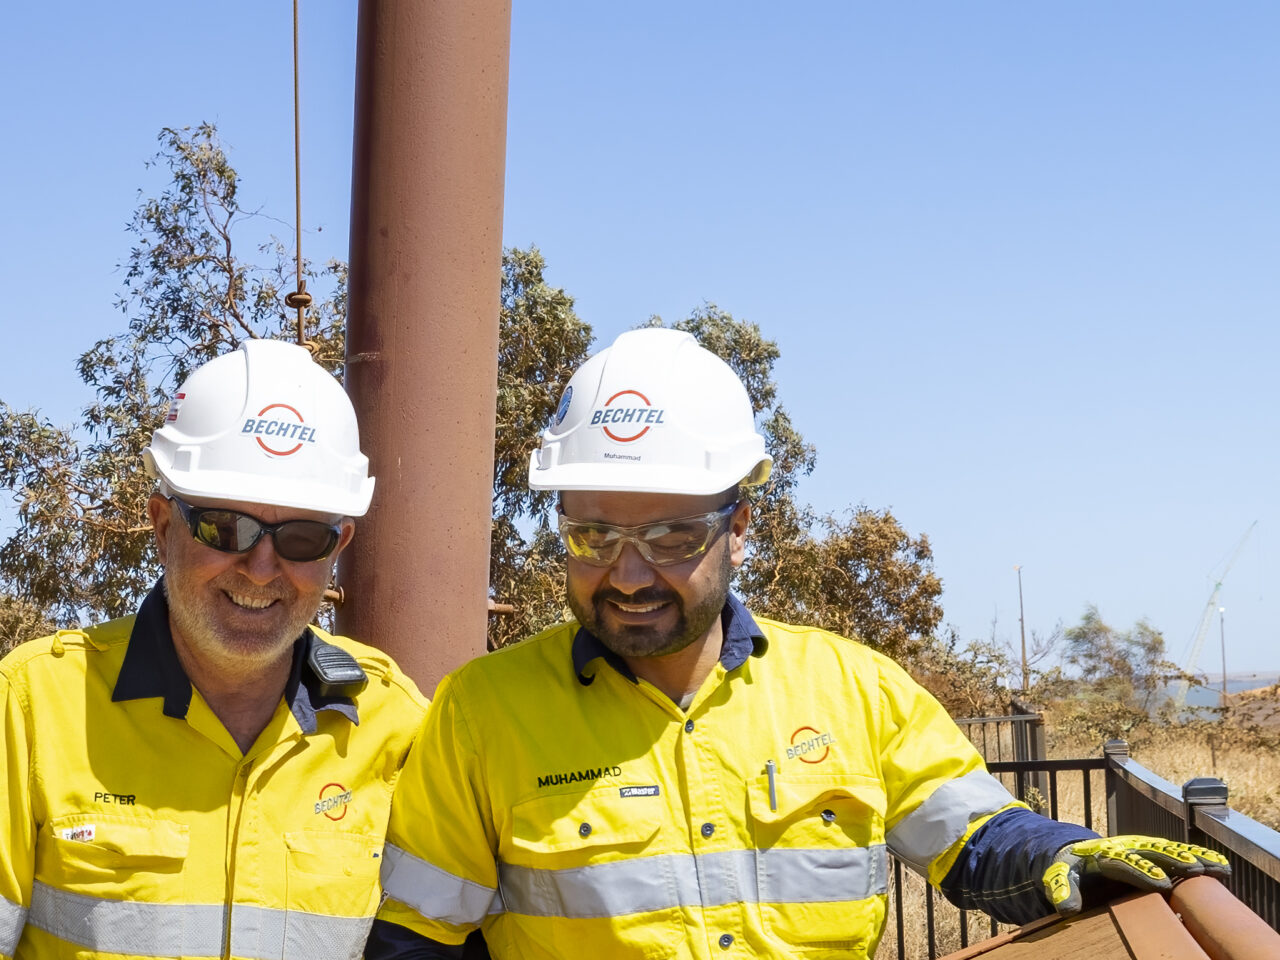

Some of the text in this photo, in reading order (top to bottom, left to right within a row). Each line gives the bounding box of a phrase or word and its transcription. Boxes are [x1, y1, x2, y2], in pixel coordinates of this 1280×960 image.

[590, 408, 665, 425] BECHTEL
[241, 418, 316, 443] BECHTEL
[604, 452, 641, 461] Muhammad
[786, 733, 836, 760] BECHTEL
[537, 766, 622, 788] MUHAMMAD
[94, 792, 136, 806] PETER
